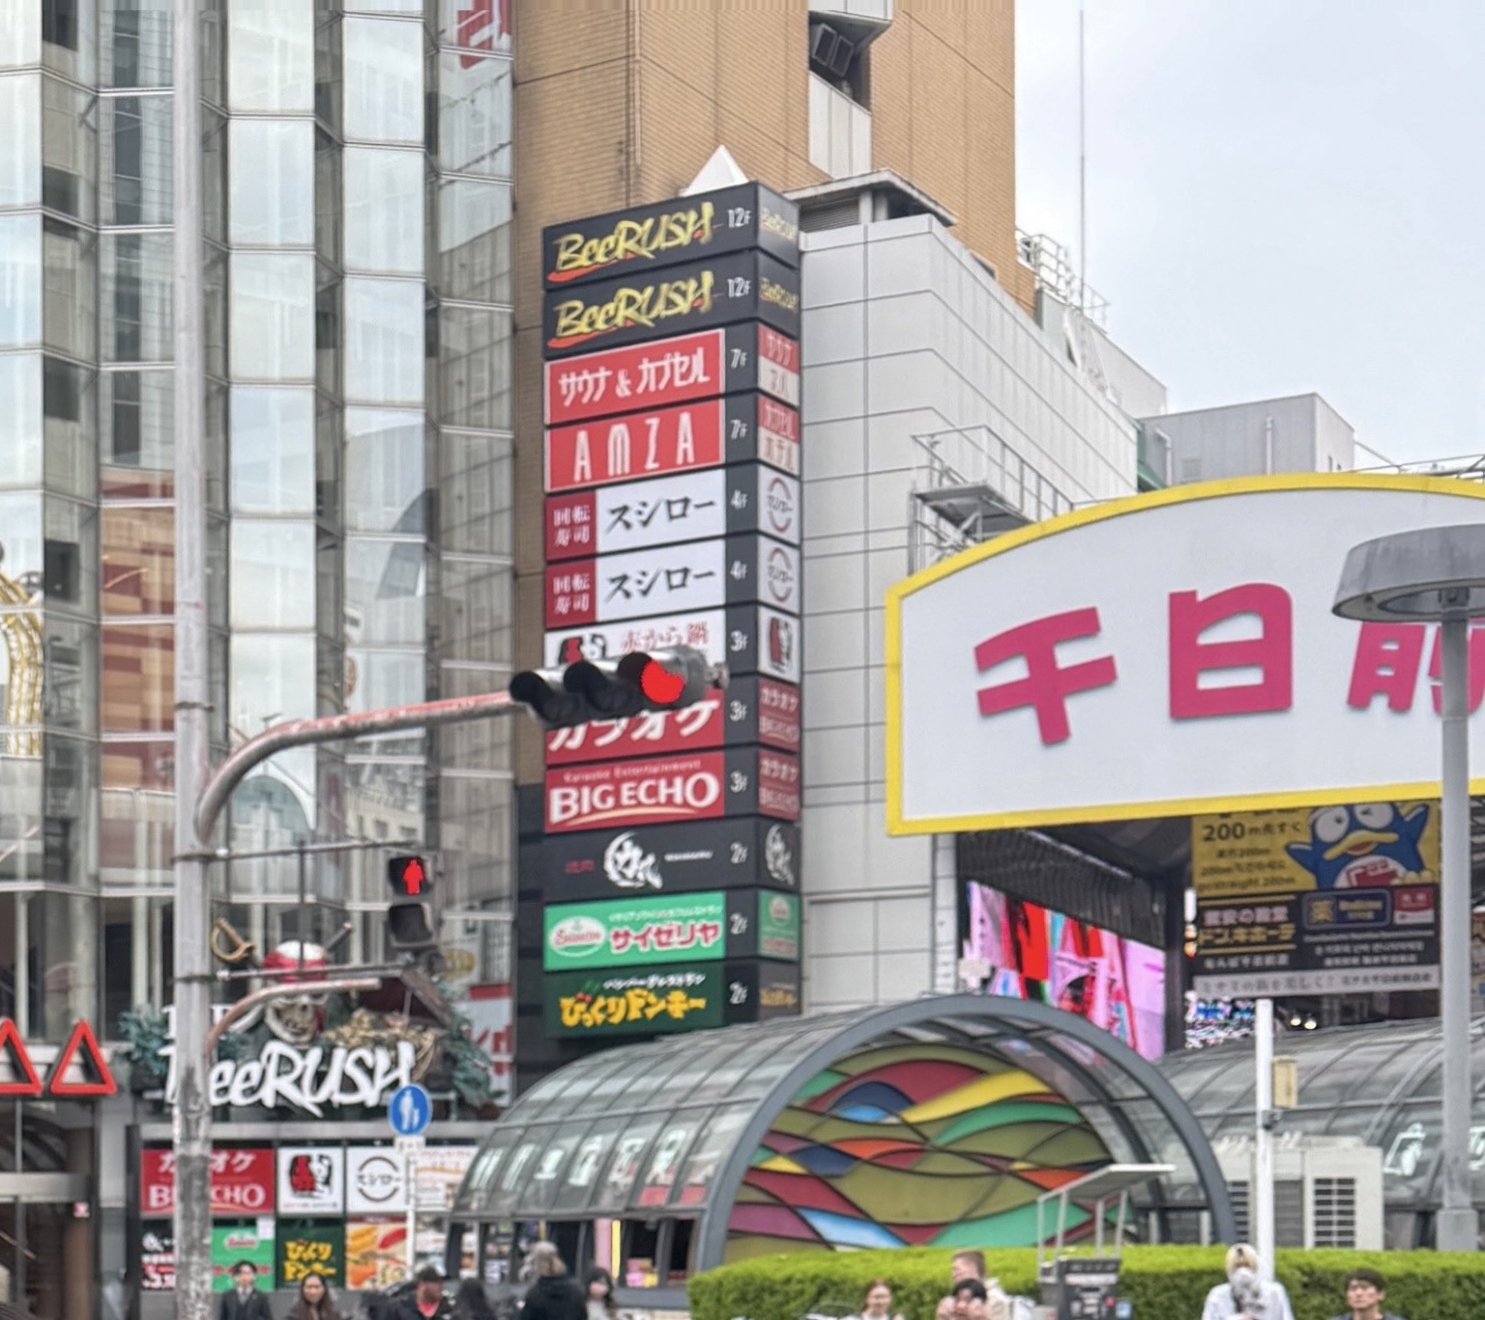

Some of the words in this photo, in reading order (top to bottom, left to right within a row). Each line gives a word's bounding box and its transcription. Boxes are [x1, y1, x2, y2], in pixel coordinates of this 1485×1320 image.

[558, 366, 612, 406] サウナ
[636, 347, 710, 394] カプセル
[574, 412, 695, 483] AMZA
[605, 496, 715, 535] スシロー
[605, 566, 715, 604] スシロー
[549, 783, 614, 824] BIG
[620, 771, 720, 808] ECHO
[610, 921, 721, 954] サイゼリヤ
[559, 988, 707, 1028] びっくりドンキー
[158, 1040, 416, 1118] eeRUSH
